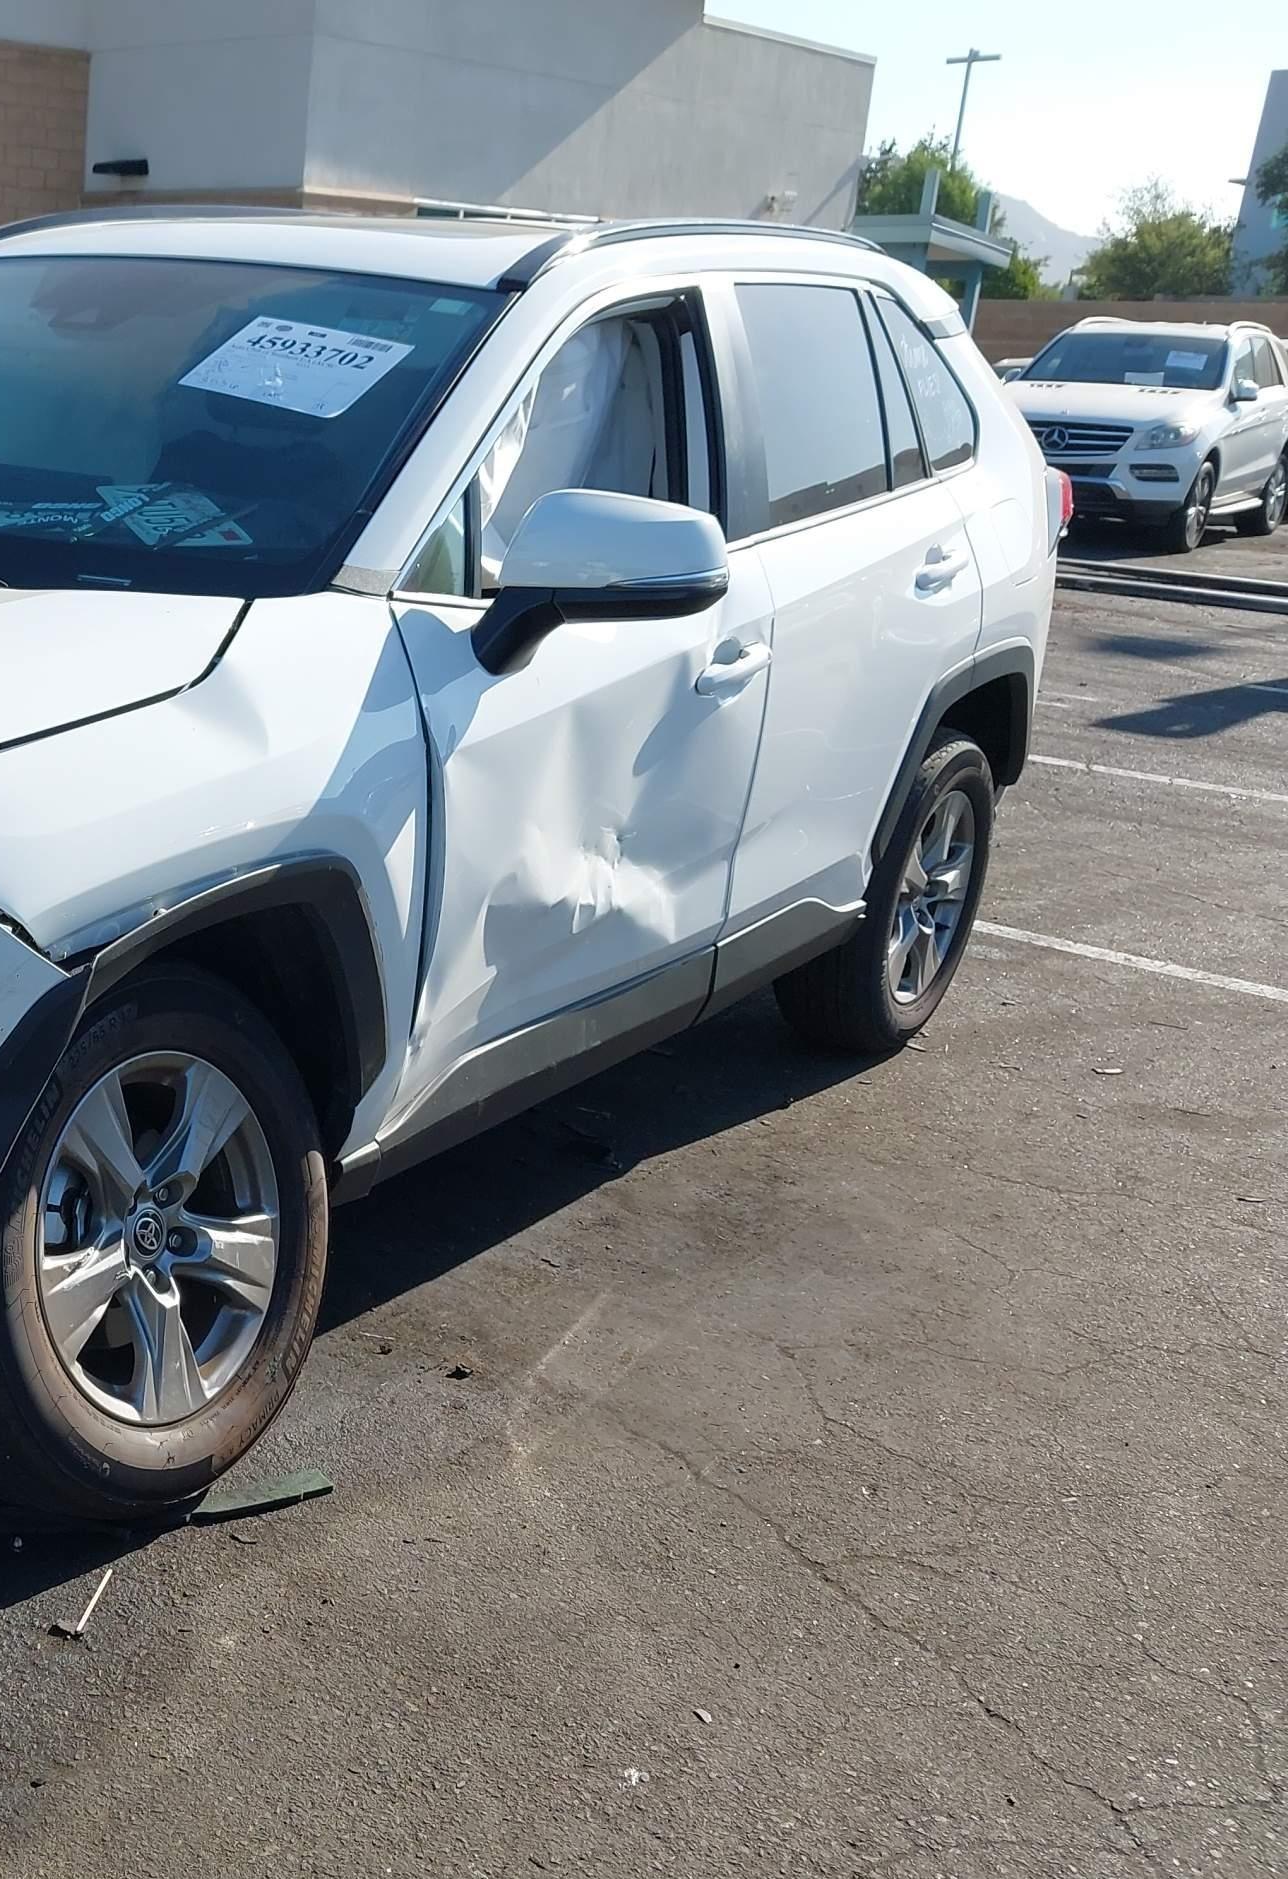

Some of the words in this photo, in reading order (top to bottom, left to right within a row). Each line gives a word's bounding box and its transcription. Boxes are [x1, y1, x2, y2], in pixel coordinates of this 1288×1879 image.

[246, 333, 375, 370] 45933702
[286, 1251, 322, 1376] MICHELIN
[238, 1390, 281, 1446] PRIMACY
